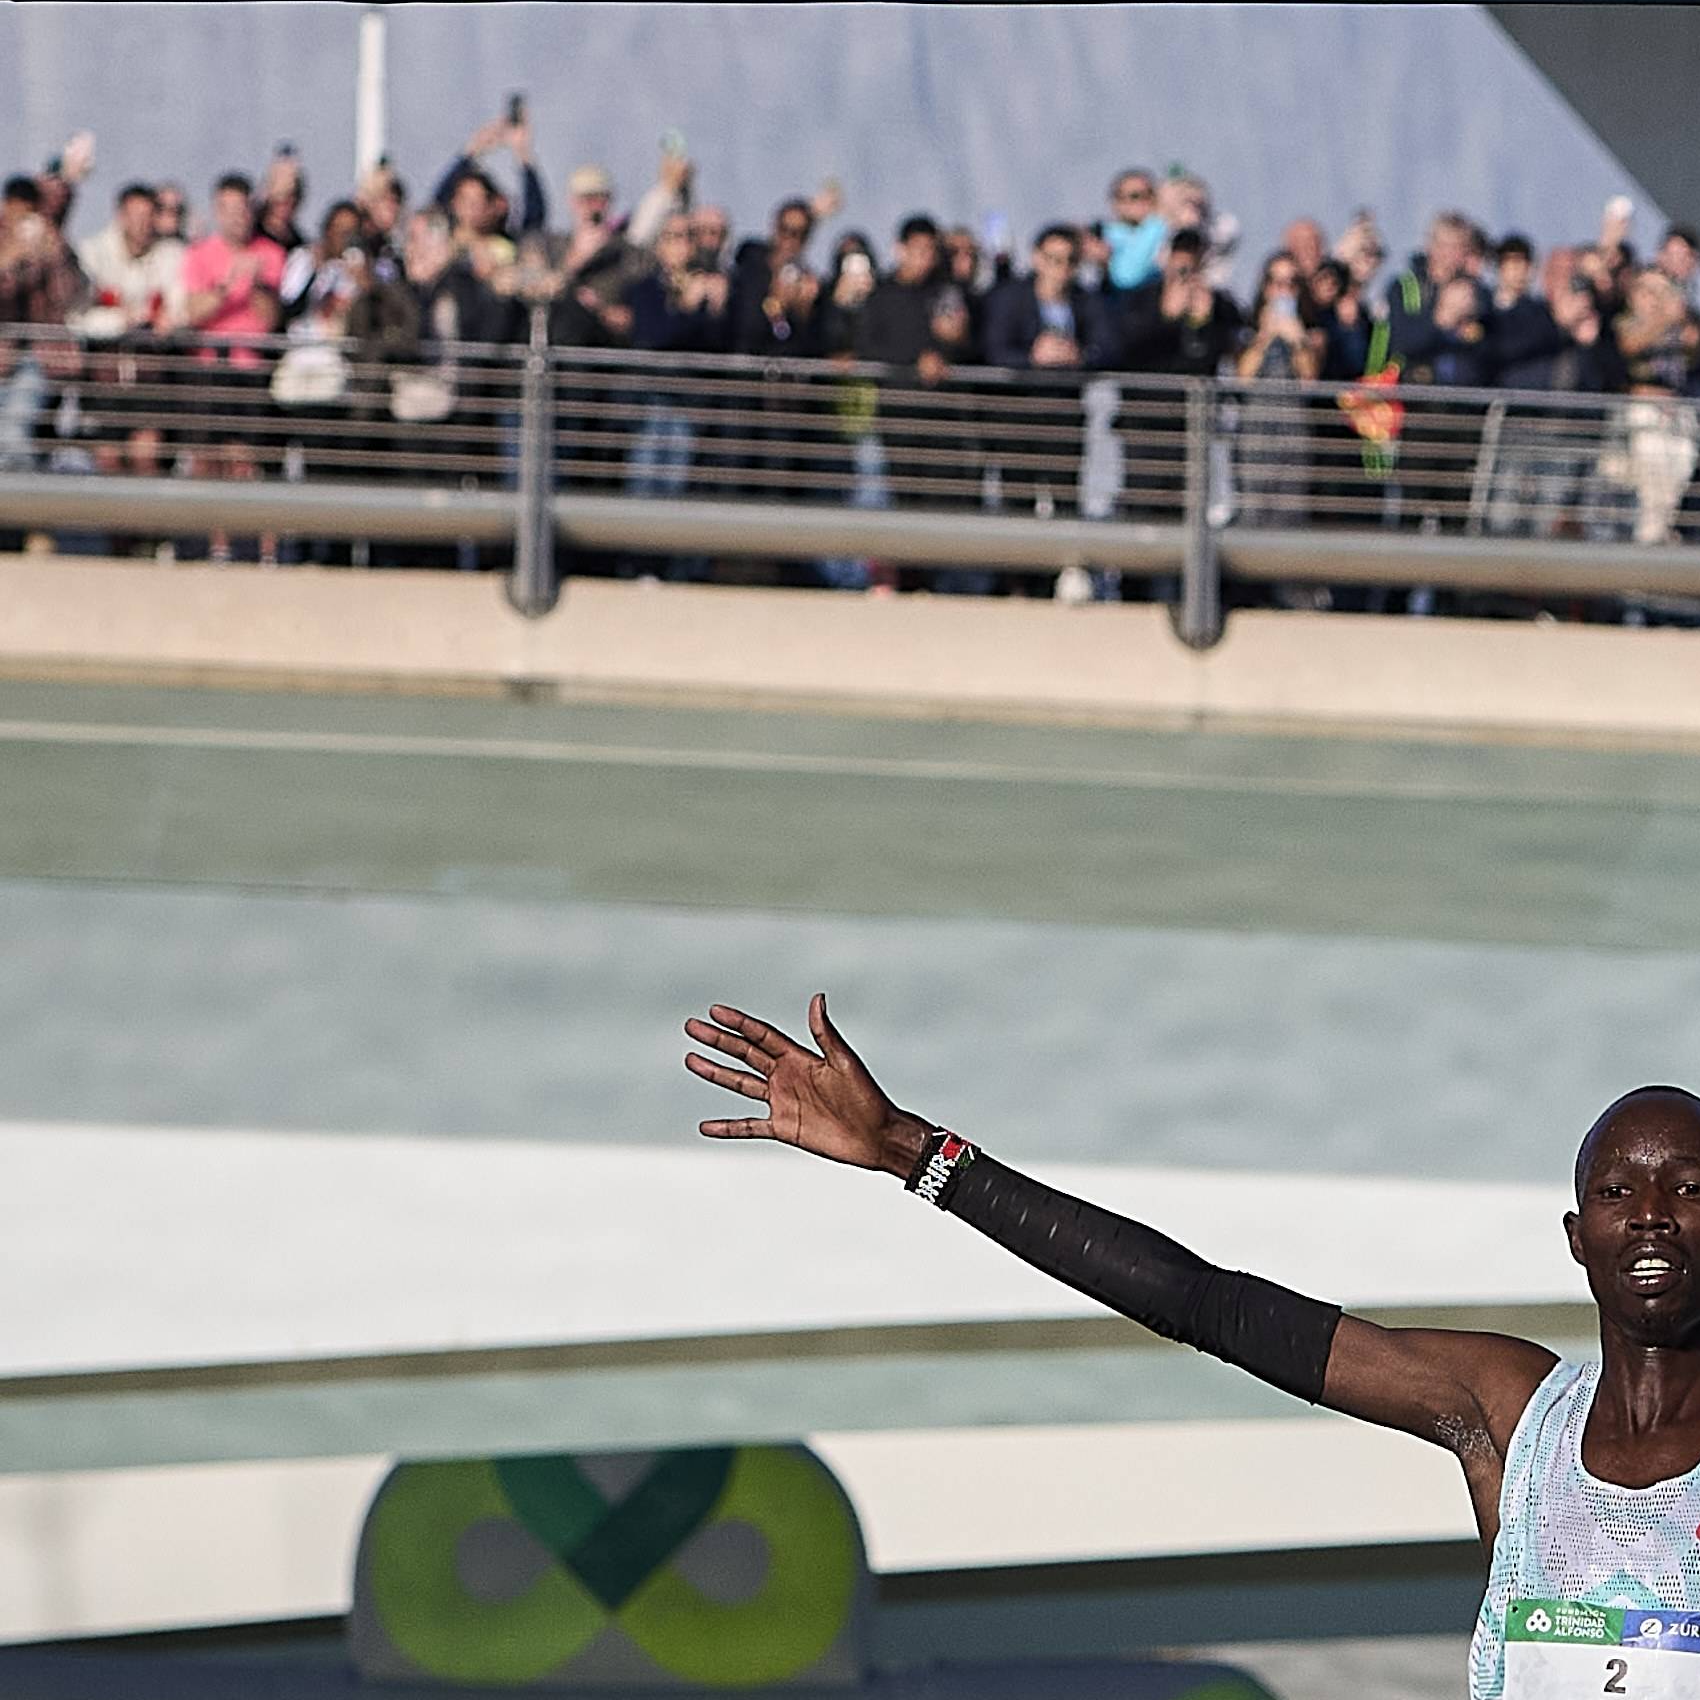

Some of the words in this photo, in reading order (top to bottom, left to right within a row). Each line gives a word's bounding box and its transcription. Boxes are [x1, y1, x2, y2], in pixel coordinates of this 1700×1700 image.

[1554, 1615, 1606, 1628] TRINIDAD
[1553, 1626, 1605, 1639] ALFONSO
[1603, 1658, 1629, 1694] 2
